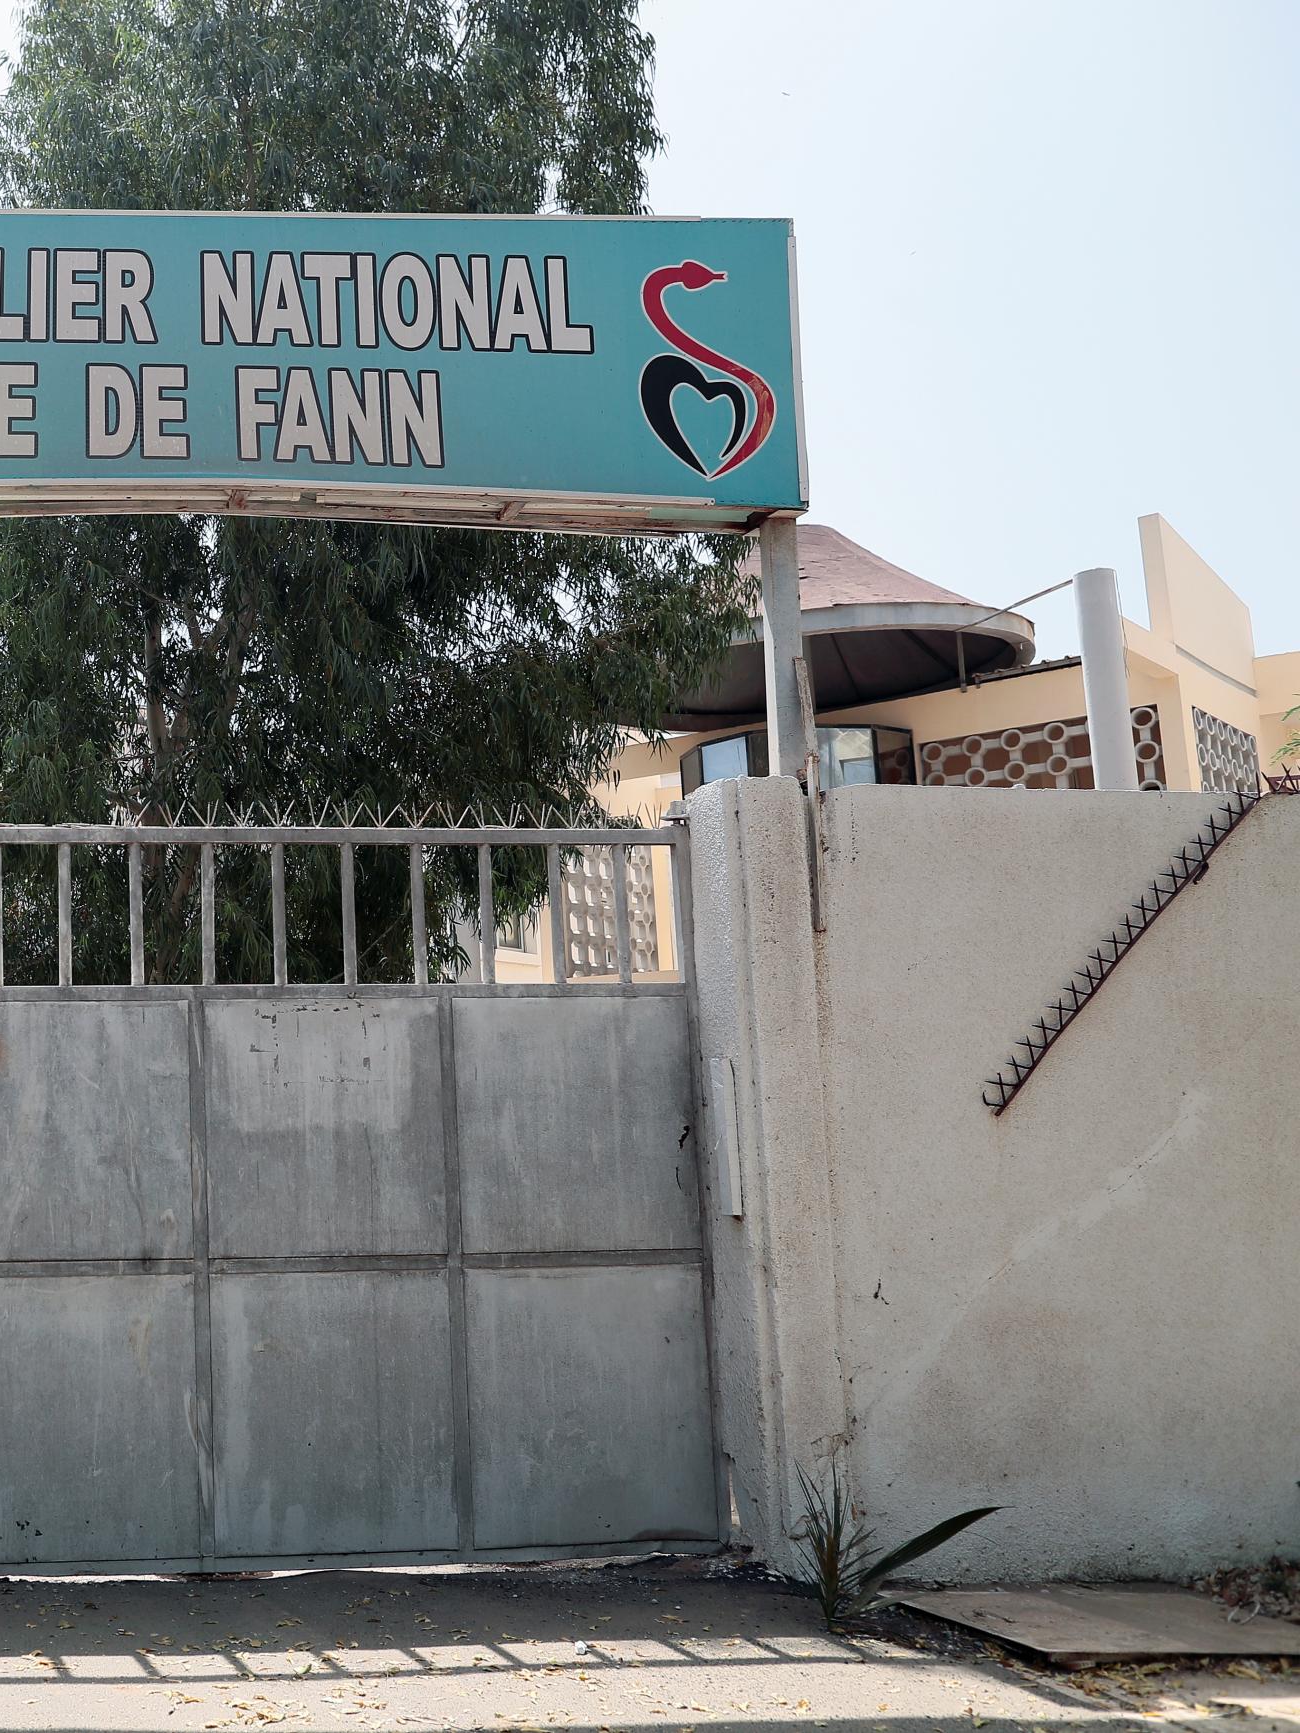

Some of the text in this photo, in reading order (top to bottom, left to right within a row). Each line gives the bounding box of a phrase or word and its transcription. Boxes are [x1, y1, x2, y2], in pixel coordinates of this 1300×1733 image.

[200, 250, 593, 353] NATIONAL
[86, 363, 190, 459] DE
[236, 365, 445, 468] FANN
